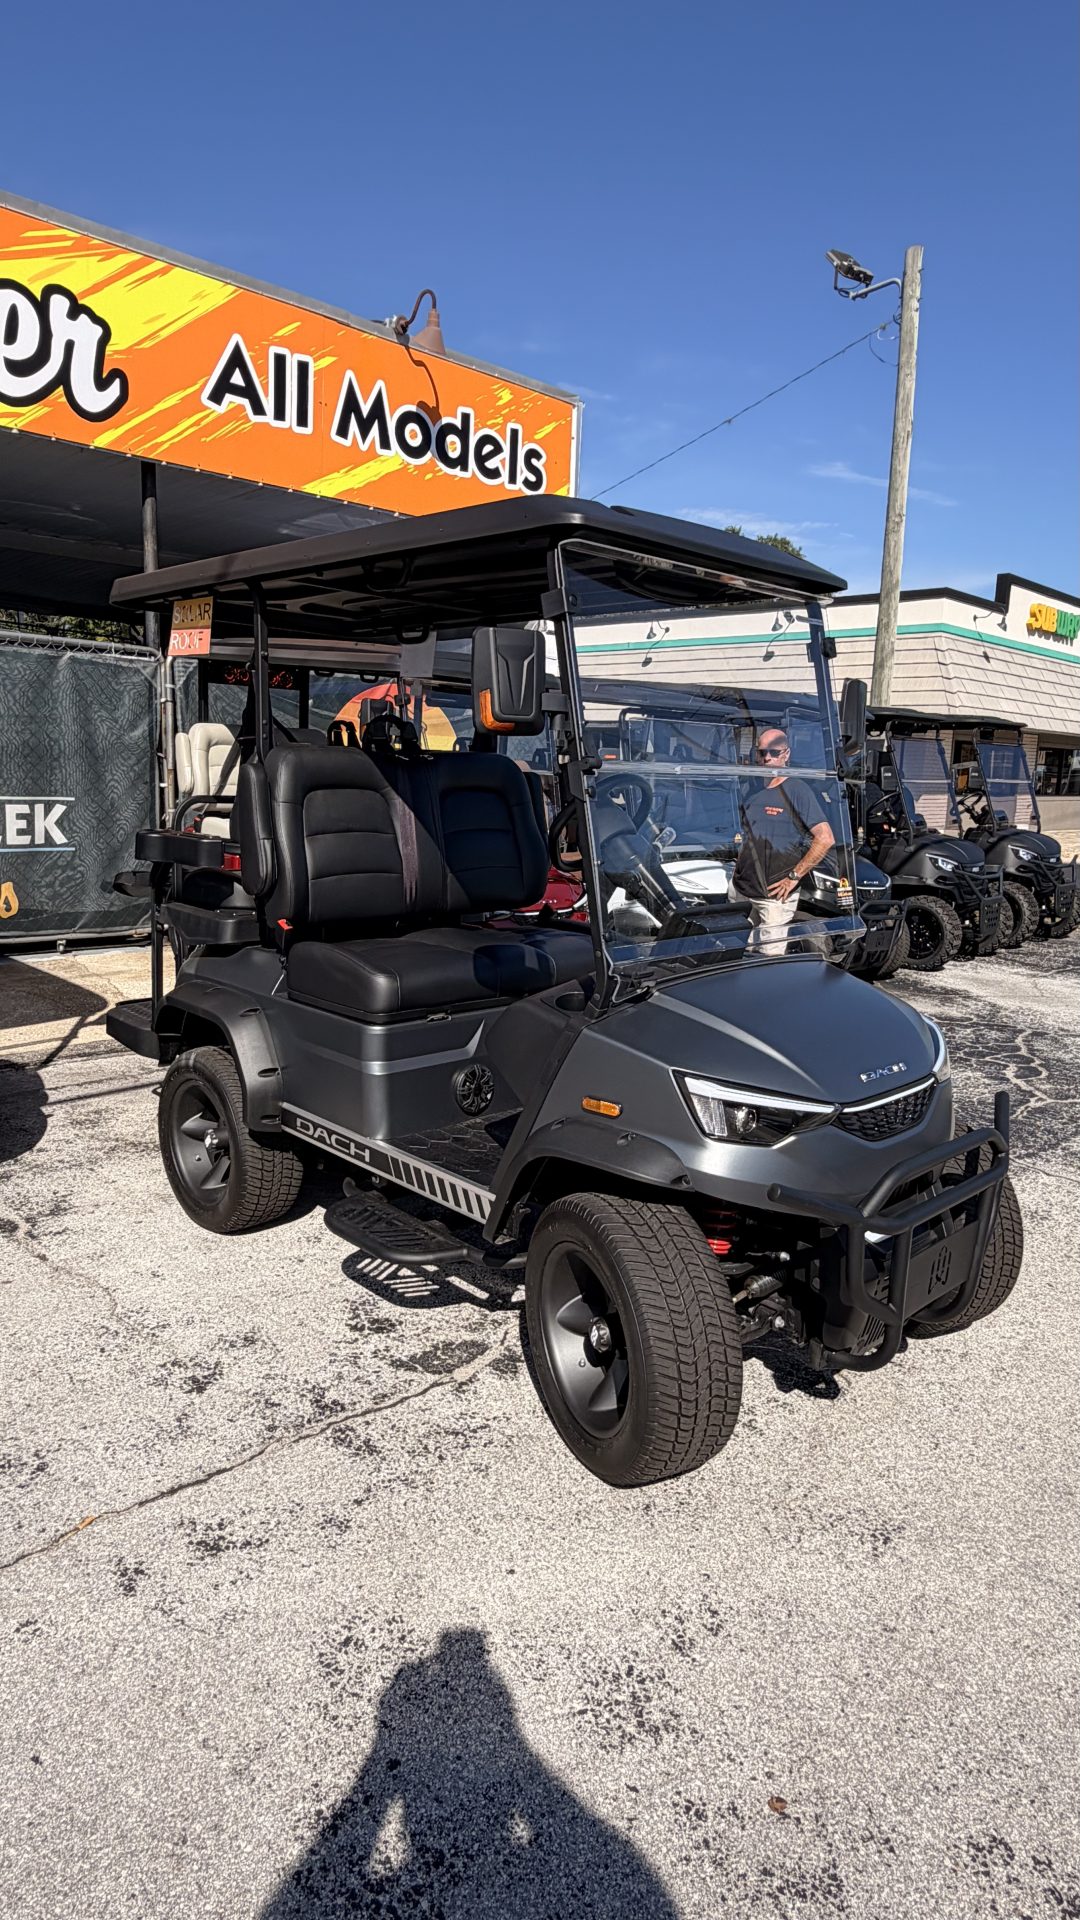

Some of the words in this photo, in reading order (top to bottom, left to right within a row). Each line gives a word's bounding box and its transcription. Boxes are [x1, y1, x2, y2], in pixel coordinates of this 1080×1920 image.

[204, 338, 312, 431] All
[334, 372, 546, 493] Models
[173, 602, 211, 624] SOLAR
[170, 630, 204, 650] ROOF
[296, 1117, 370, 1163] DACH
